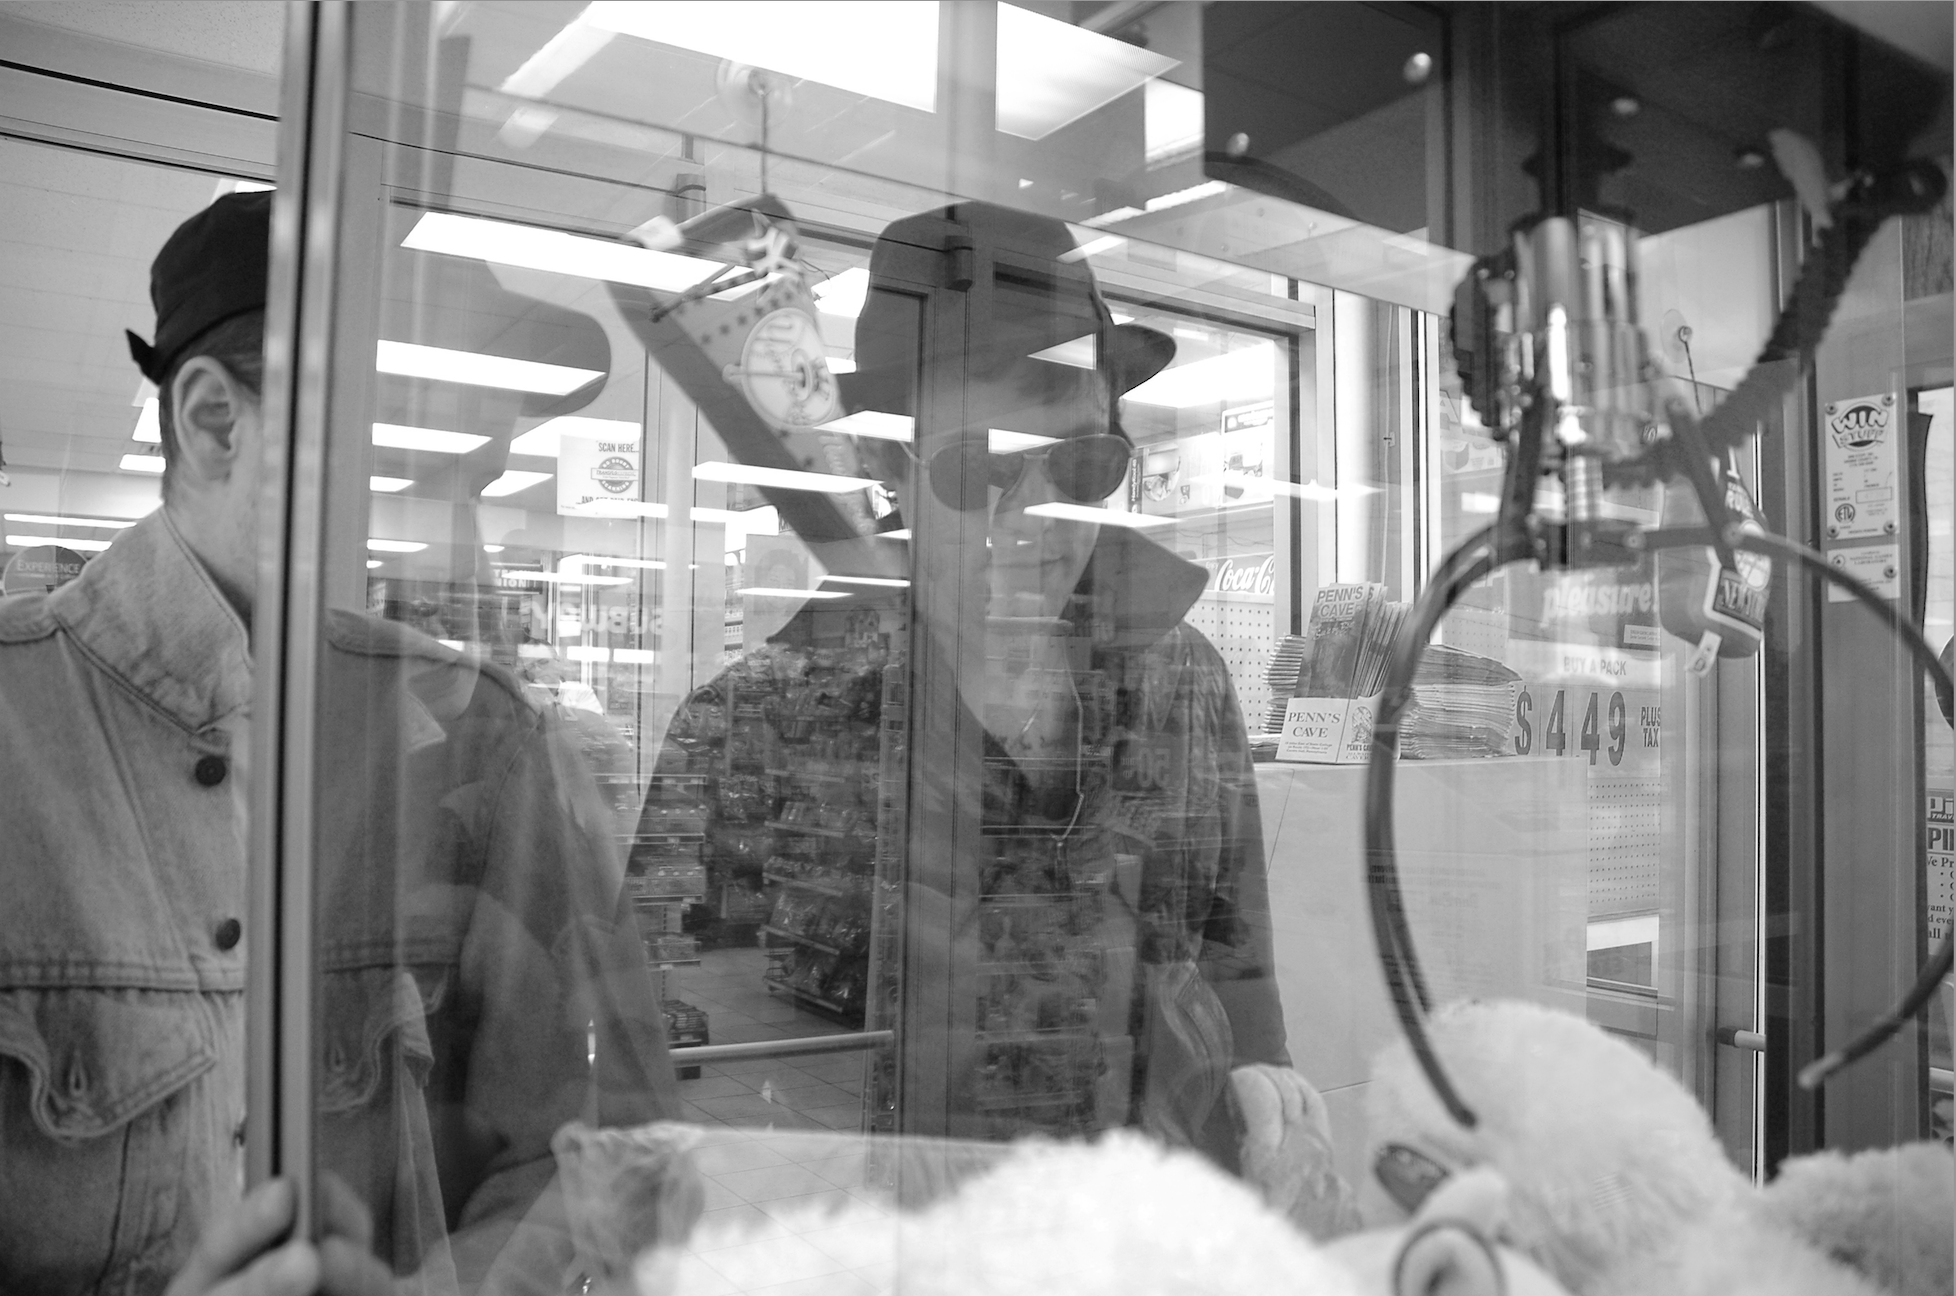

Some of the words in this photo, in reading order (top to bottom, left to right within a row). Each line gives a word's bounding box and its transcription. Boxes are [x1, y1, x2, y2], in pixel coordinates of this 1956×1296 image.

[1831, 408, 1889, 434] WIN
[598, 442, 616, 453] SCAN
[1317, 586, 1363, 603] PENN'S
[1320, 602, 1355, 617] CAVE
[1564, 656, 1586, 673] BUY
[1589, 657, 1598, 672] A
[1601, 660, 1627, 676] PACK
[1288, 712, 1340, 723] PENN'S
[1640, 706, 1661, 727] PLUS
[1292, 726, 1328, 738] CAVE
[1643, 728, 1659, 748] TAX
